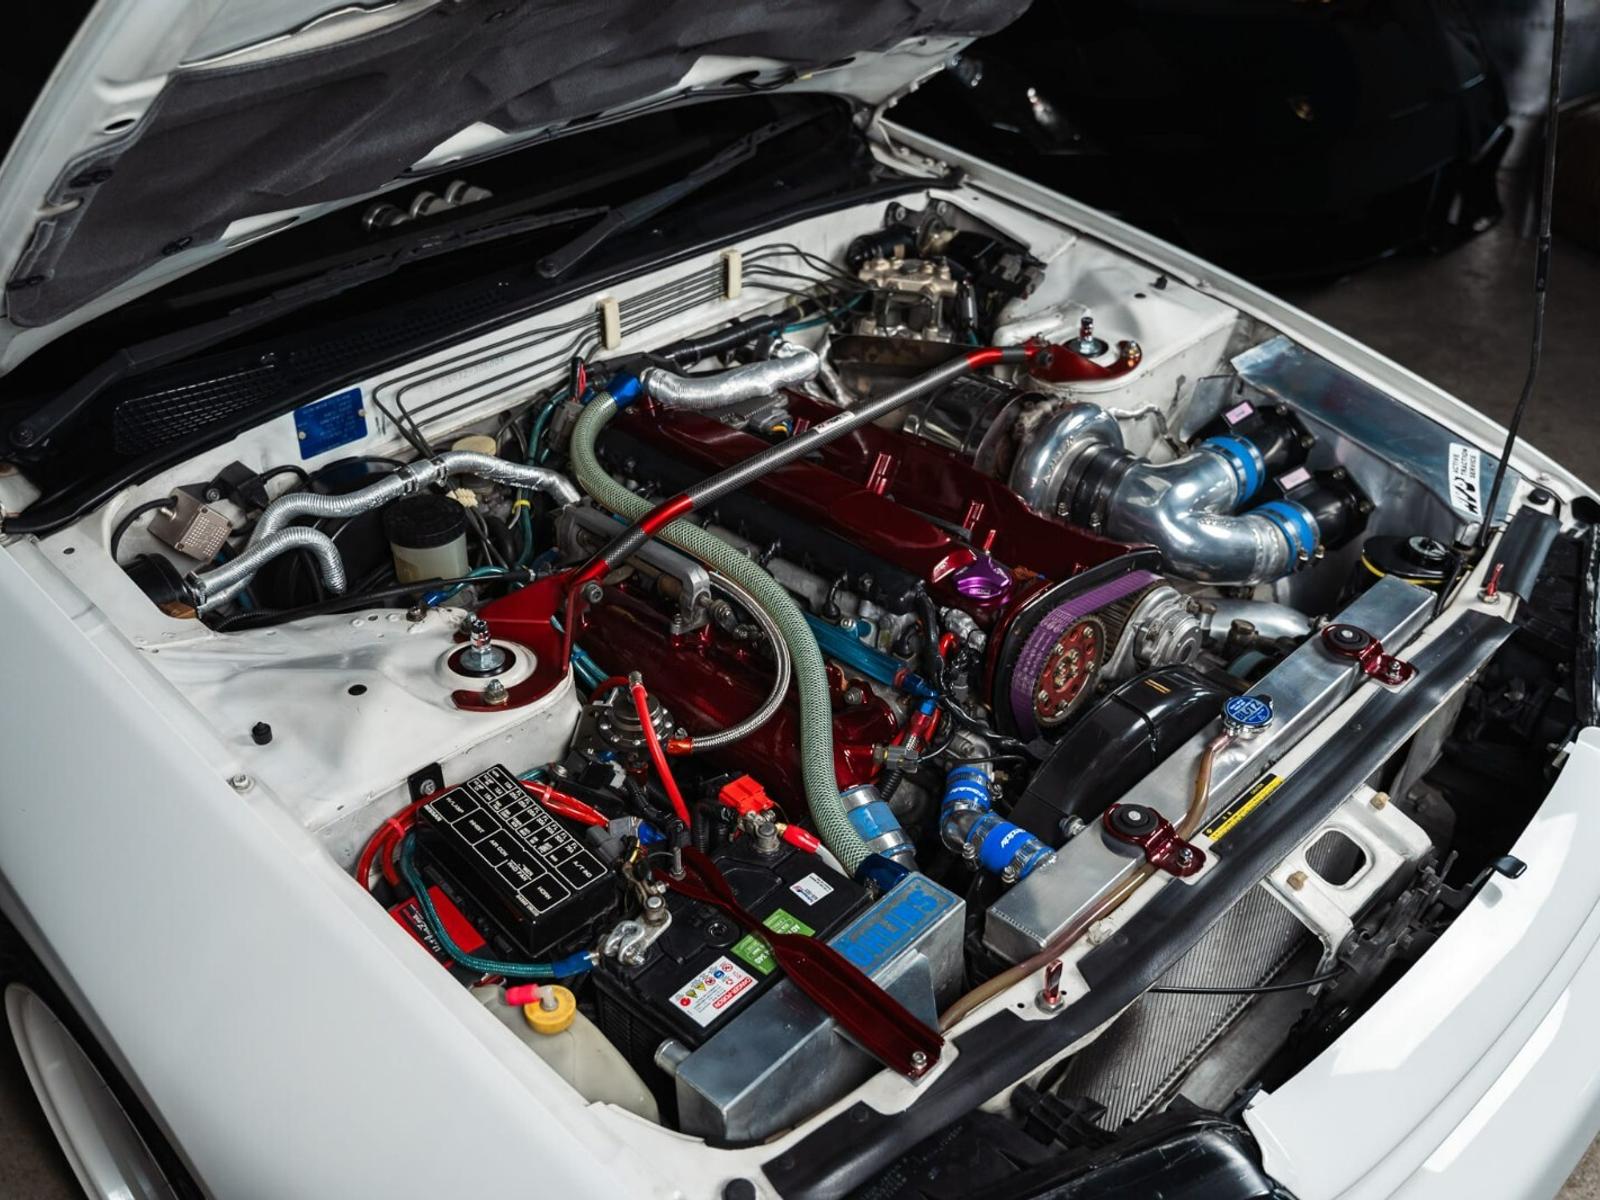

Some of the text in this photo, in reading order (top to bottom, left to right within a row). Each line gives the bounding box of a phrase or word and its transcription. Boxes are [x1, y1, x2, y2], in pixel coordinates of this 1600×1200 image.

[1234, 700, 1260, 719] BLITZ
[446, 797, 465, 813] H/LAMP
[537, 886, 552, 900] HORN
